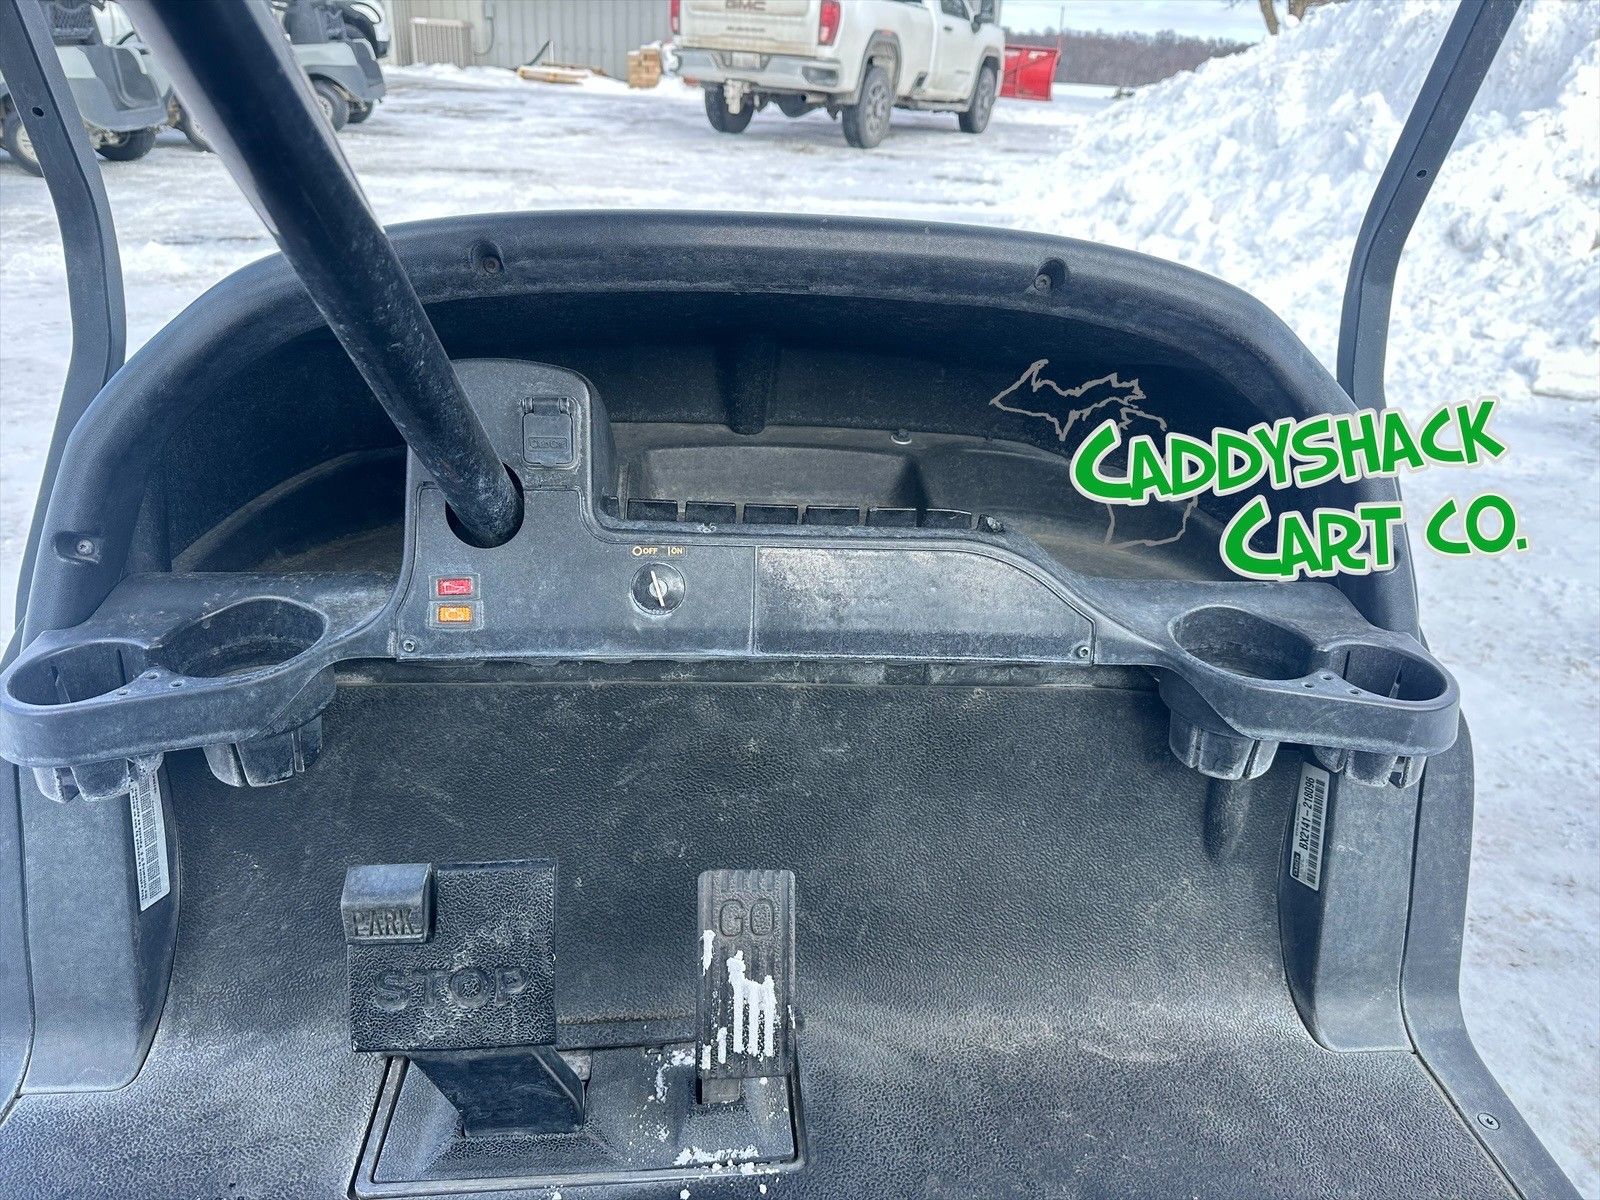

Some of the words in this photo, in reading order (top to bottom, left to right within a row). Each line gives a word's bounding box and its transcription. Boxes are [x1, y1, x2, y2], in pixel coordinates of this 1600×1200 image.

[725, 0, 766, 11] GMC
[353, 909, 415, 936] PARK
[719, 898, 775, 937] GO
[373, 967, 528, 1011] STOP
